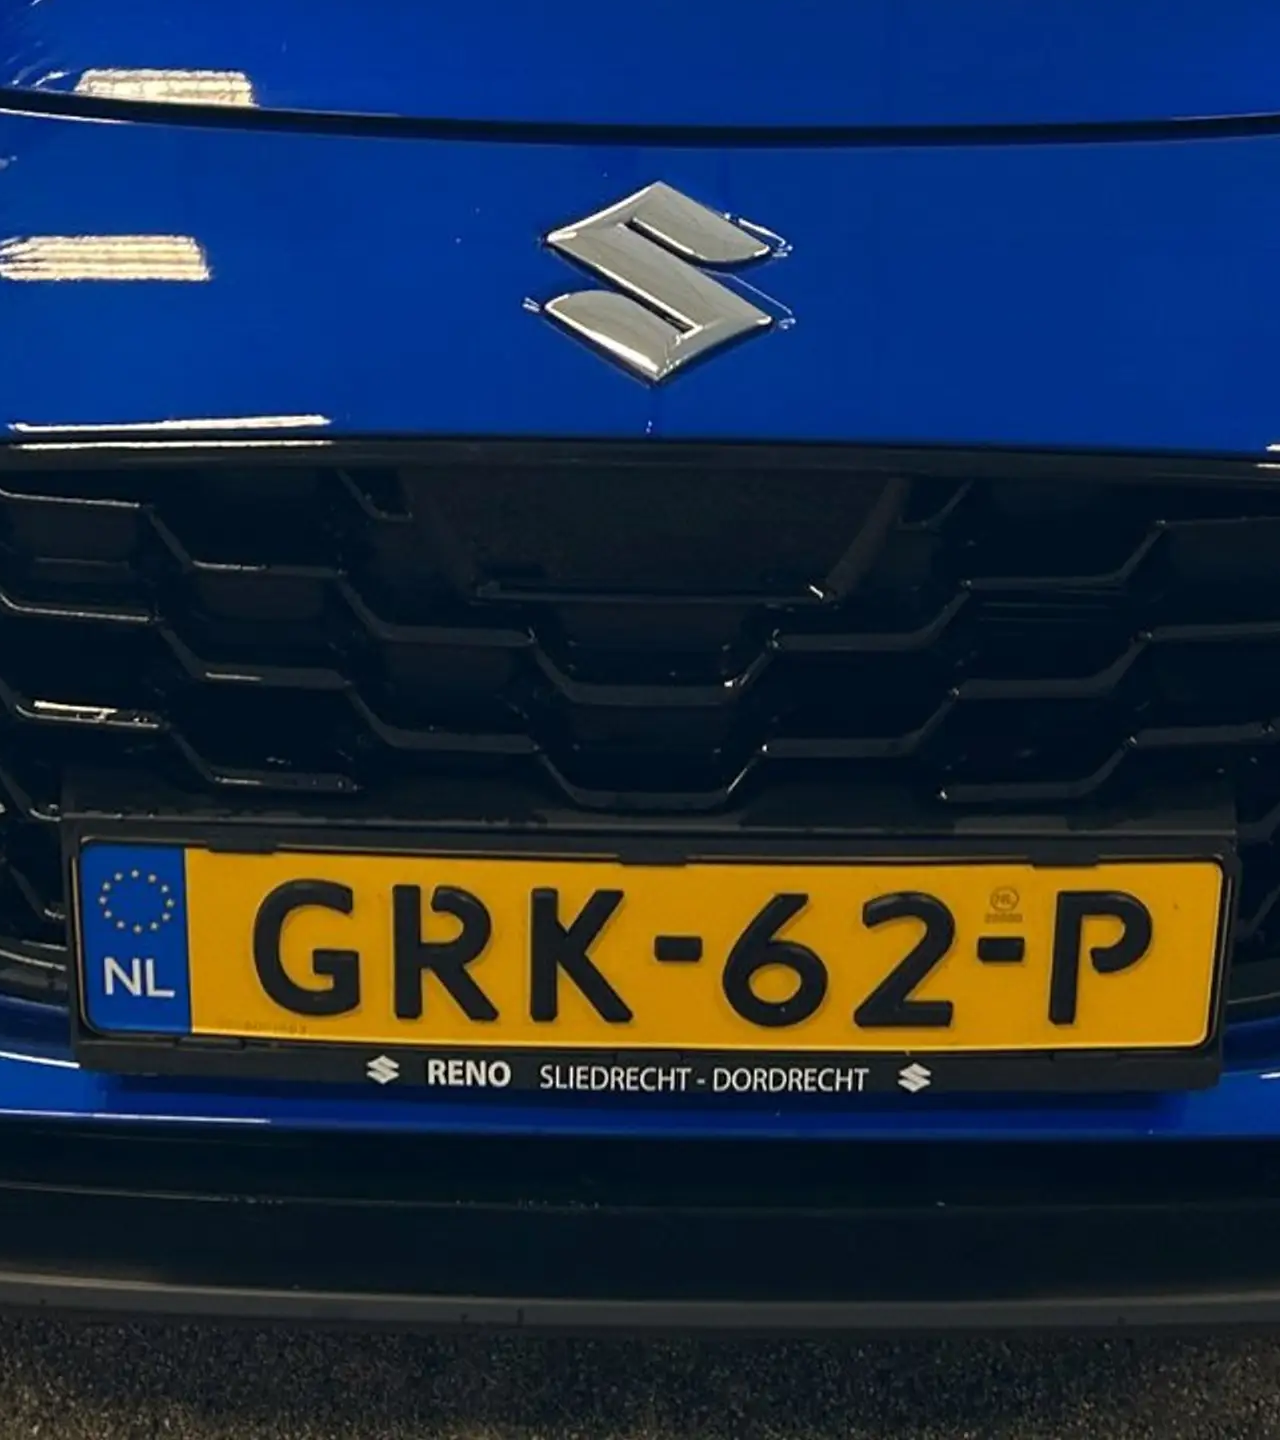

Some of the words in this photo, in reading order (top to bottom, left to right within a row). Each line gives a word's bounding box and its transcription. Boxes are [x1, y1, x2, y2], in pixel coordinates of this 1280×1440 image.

[252, 877, 1153, 1028] GRK-62-P
[104, 956, 175, 998] NL
[427, 1059, 512, 1087] RENO
[539, 1064, 692, 1092] SLIEDRECHT
[713, 1067, 870, 1093] DORDRECHT
